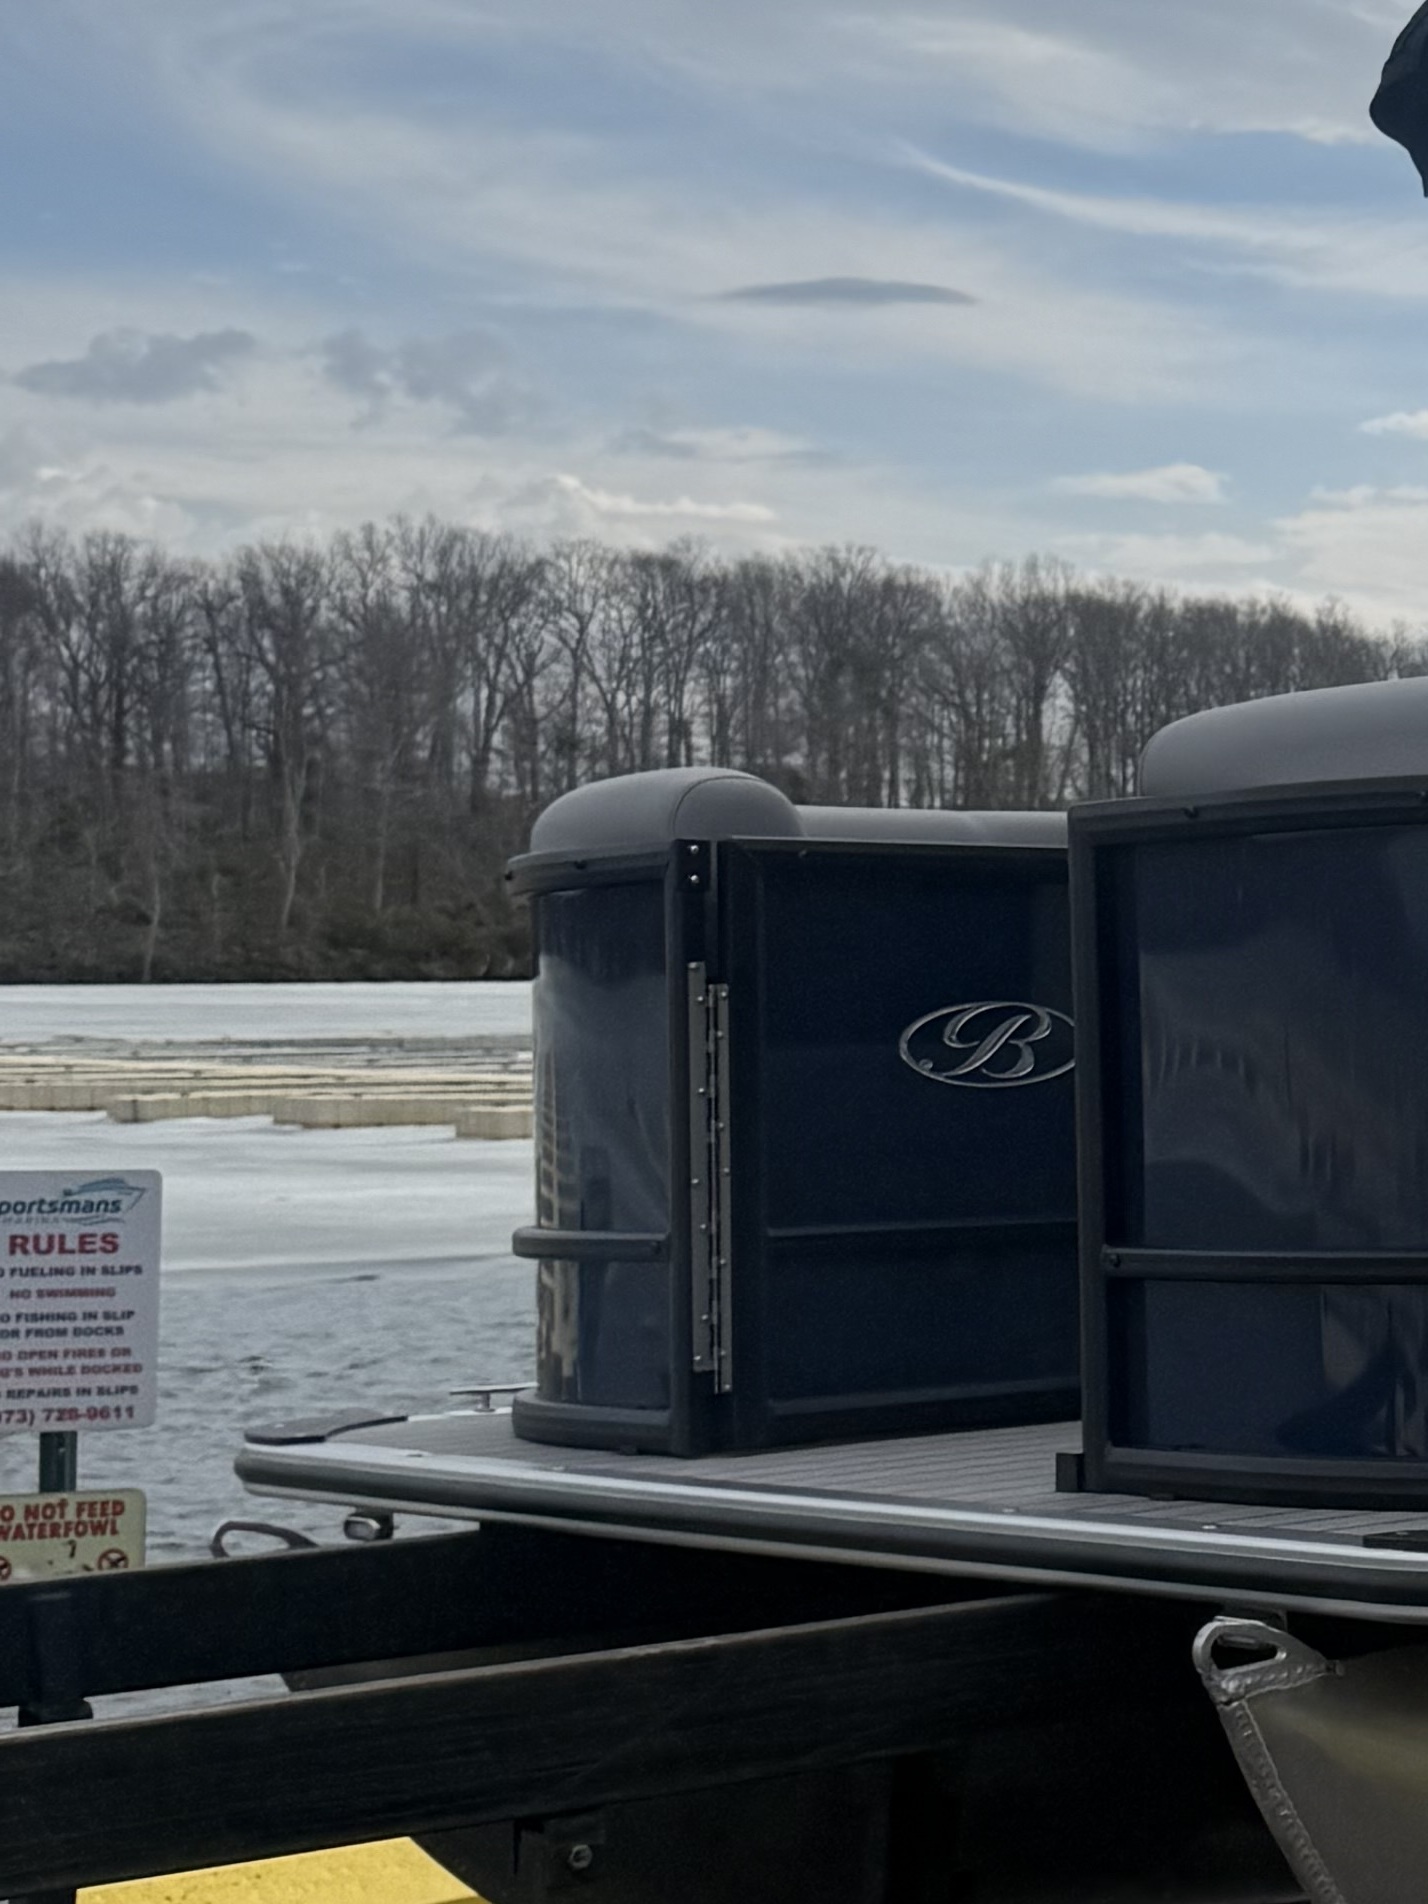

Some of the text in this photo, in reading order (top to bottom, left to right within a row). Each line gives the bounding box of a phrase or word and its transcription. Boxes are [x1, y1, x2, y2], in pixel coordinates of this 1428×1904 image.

[0, 1198, 122, 1216] portsmans
[9, 1232, 119, 1256] RULES
[9, 1266, 75, 1278] FUELING
[81, 1265, 96, 1276] IN
[101, 1264, 143, 1276] SLIPS
[10, 1287, 116, 1299] NO SWIMMING
[15, 1311, 77, 1323] FISHING
[83, 1310, 97, 1321] IN
[103, 1310, 135, 1321] SLIP
[25, 1327, 68, 1338] FROM
[73, 1326, 124, 1337] DOCKS
[0, 1347, 132, 1361] O OPEN FIRES OR
[28, 1365, 76, 1377] WHILE
[81, 1363, 143, 1374] DOCKED
[6, 1385, 139, 1399] REPAIRS IN SLIPS
[0, 1408, 35, 1427] 73)
[0, 1498, 125, 1522] O NOT FEED
